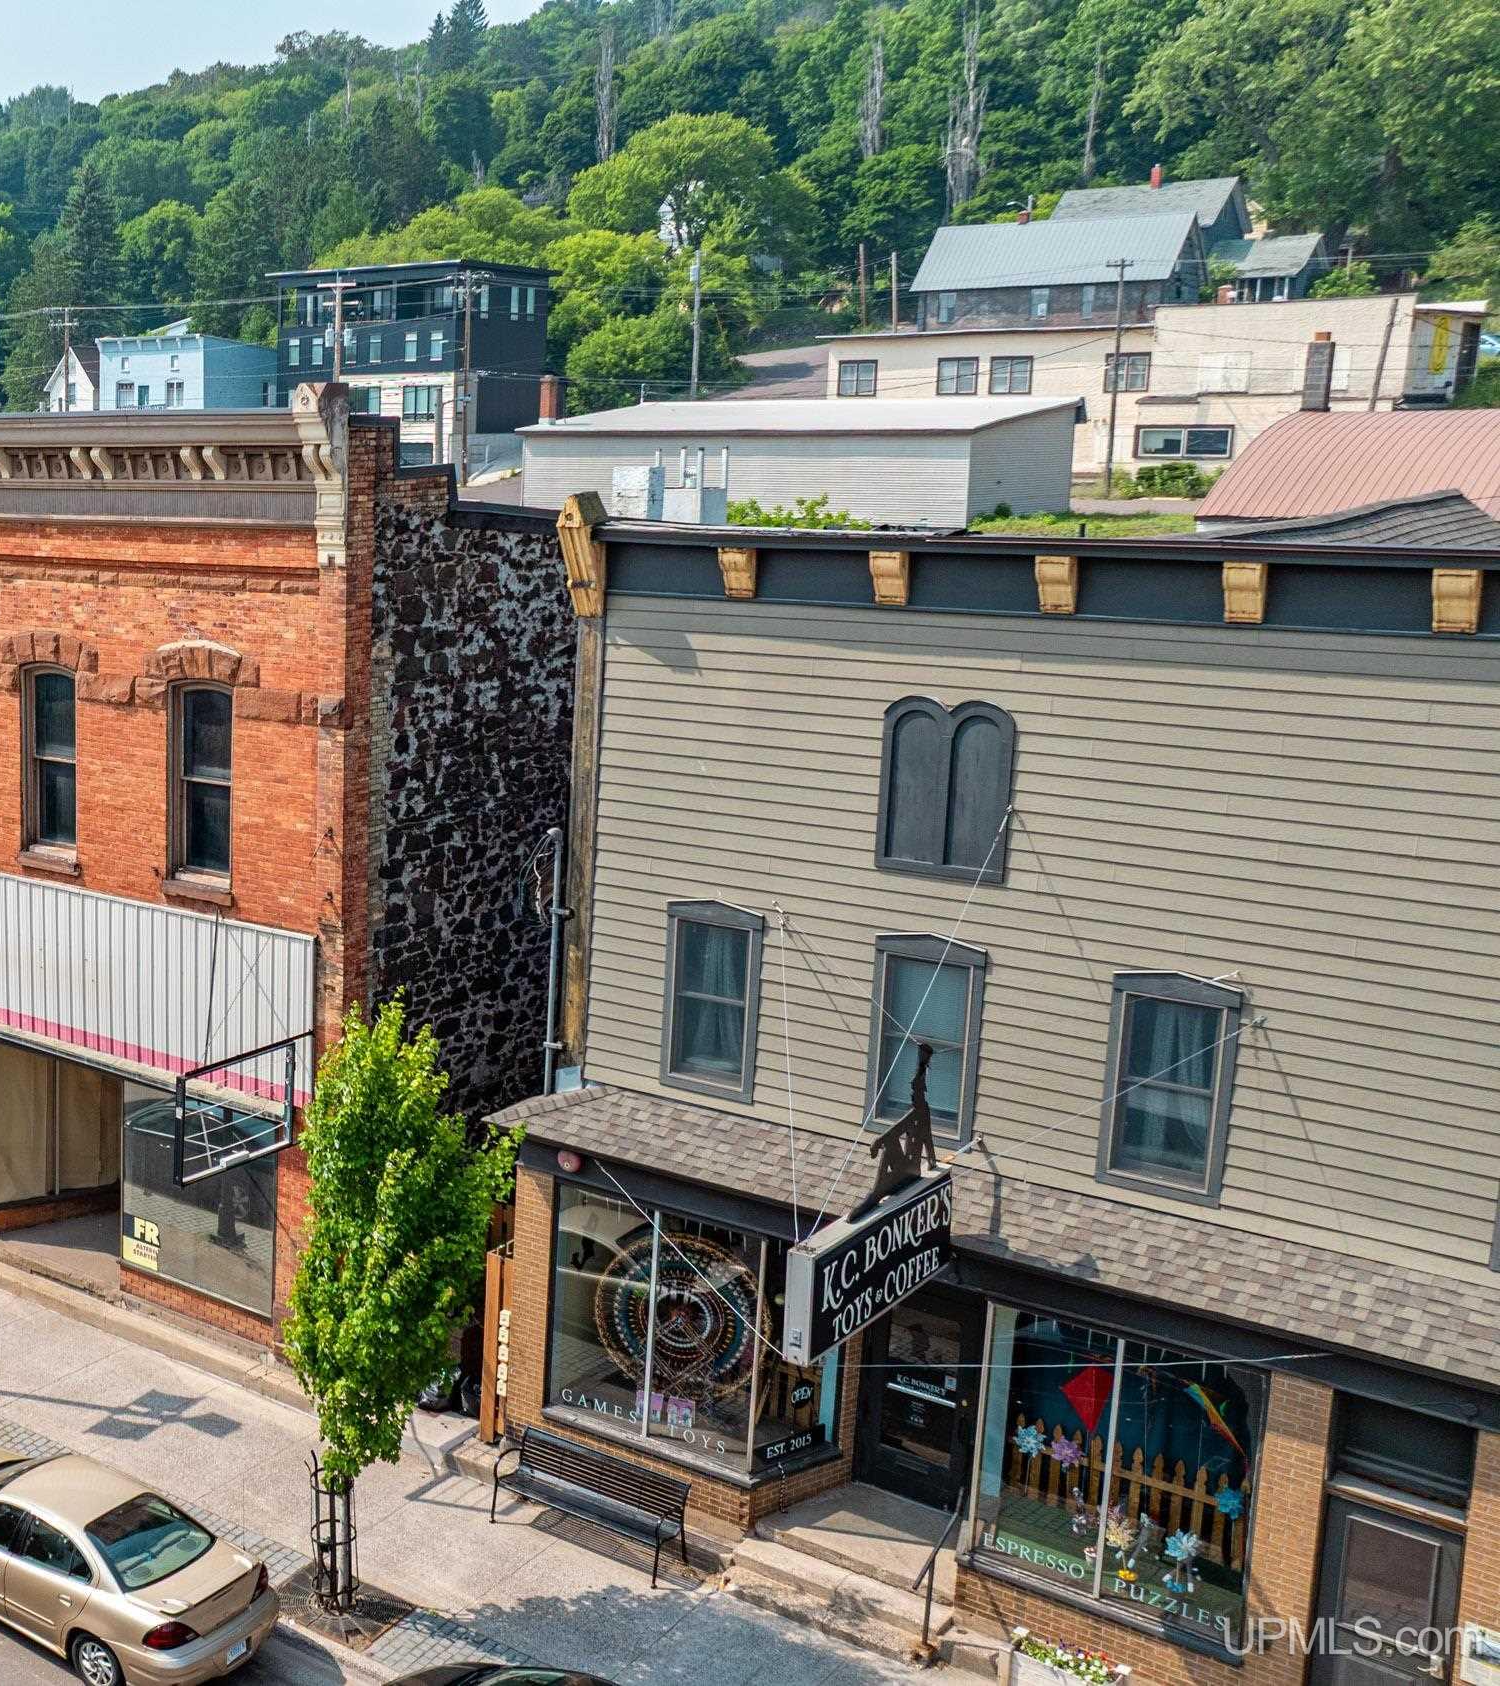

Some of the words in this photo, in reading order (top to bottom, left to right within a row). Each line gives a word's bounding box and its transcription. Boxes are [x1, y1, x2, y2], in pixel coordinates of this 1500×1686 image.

[821, 1250, 860, 1313] K.C.
[864, 1184, 952, 1274] BONKER'S
[832, 1287, 873, 1342] TOYS
[884, 1246, 940, 1304] COFFEE
[561, 1388, 637, 1424] GAMES
[791, 1386, 814, 1404] OPEN
[668, 1424, 726, 1454] TOYS
[766, 1442, 787, 1459] EST.
[790, 1433, 812, 1451] 2015
[981, 1532, 1085, 1580] ESPRESSO
[1114, 1577, 1228, 1632] PUZZLES
